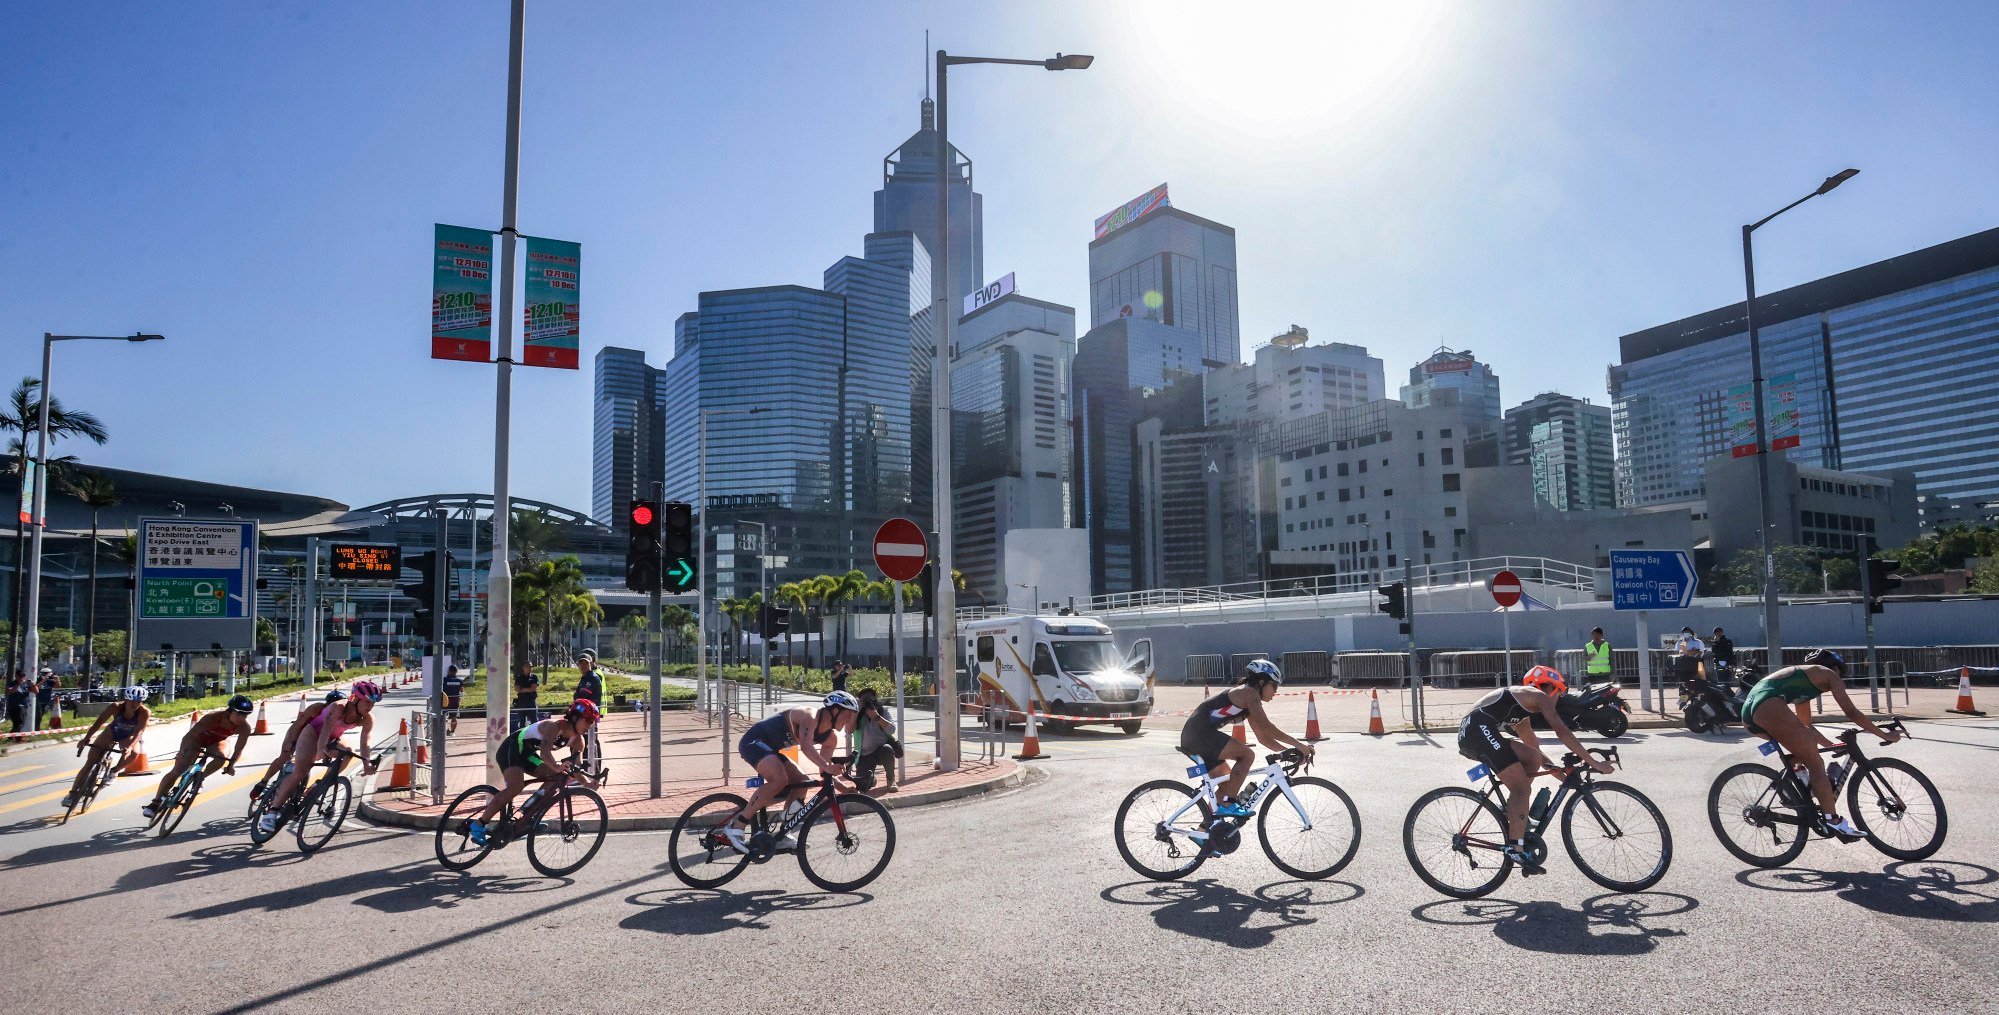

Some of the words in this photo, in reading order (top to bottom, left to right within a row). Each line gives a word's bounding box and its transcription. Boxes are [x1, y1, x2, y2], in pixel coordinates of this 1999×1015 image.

[455, 258, 488, 268] 12月10日
[472, 270, 488, 280] Dec
[544, 269, 576, 280] 12月10日
[561, 281, 576, 290] Dec
[974, 282, 1001, 308] FWD
[438, 292, 476, 309] 1210
[530, 301, 564, 318] 1210
[149, 547, 238, 555] 香港會議展覽中心
[1613, 556, 1646, 564] Causeway
[1647, 556, 1660, 564] Bay
[1615, 568, 1642, 578] 銅鑼灣
[1646, 581, 1658, 589] (C)
[1617, 592, 1652, 603] 九龍(中)
